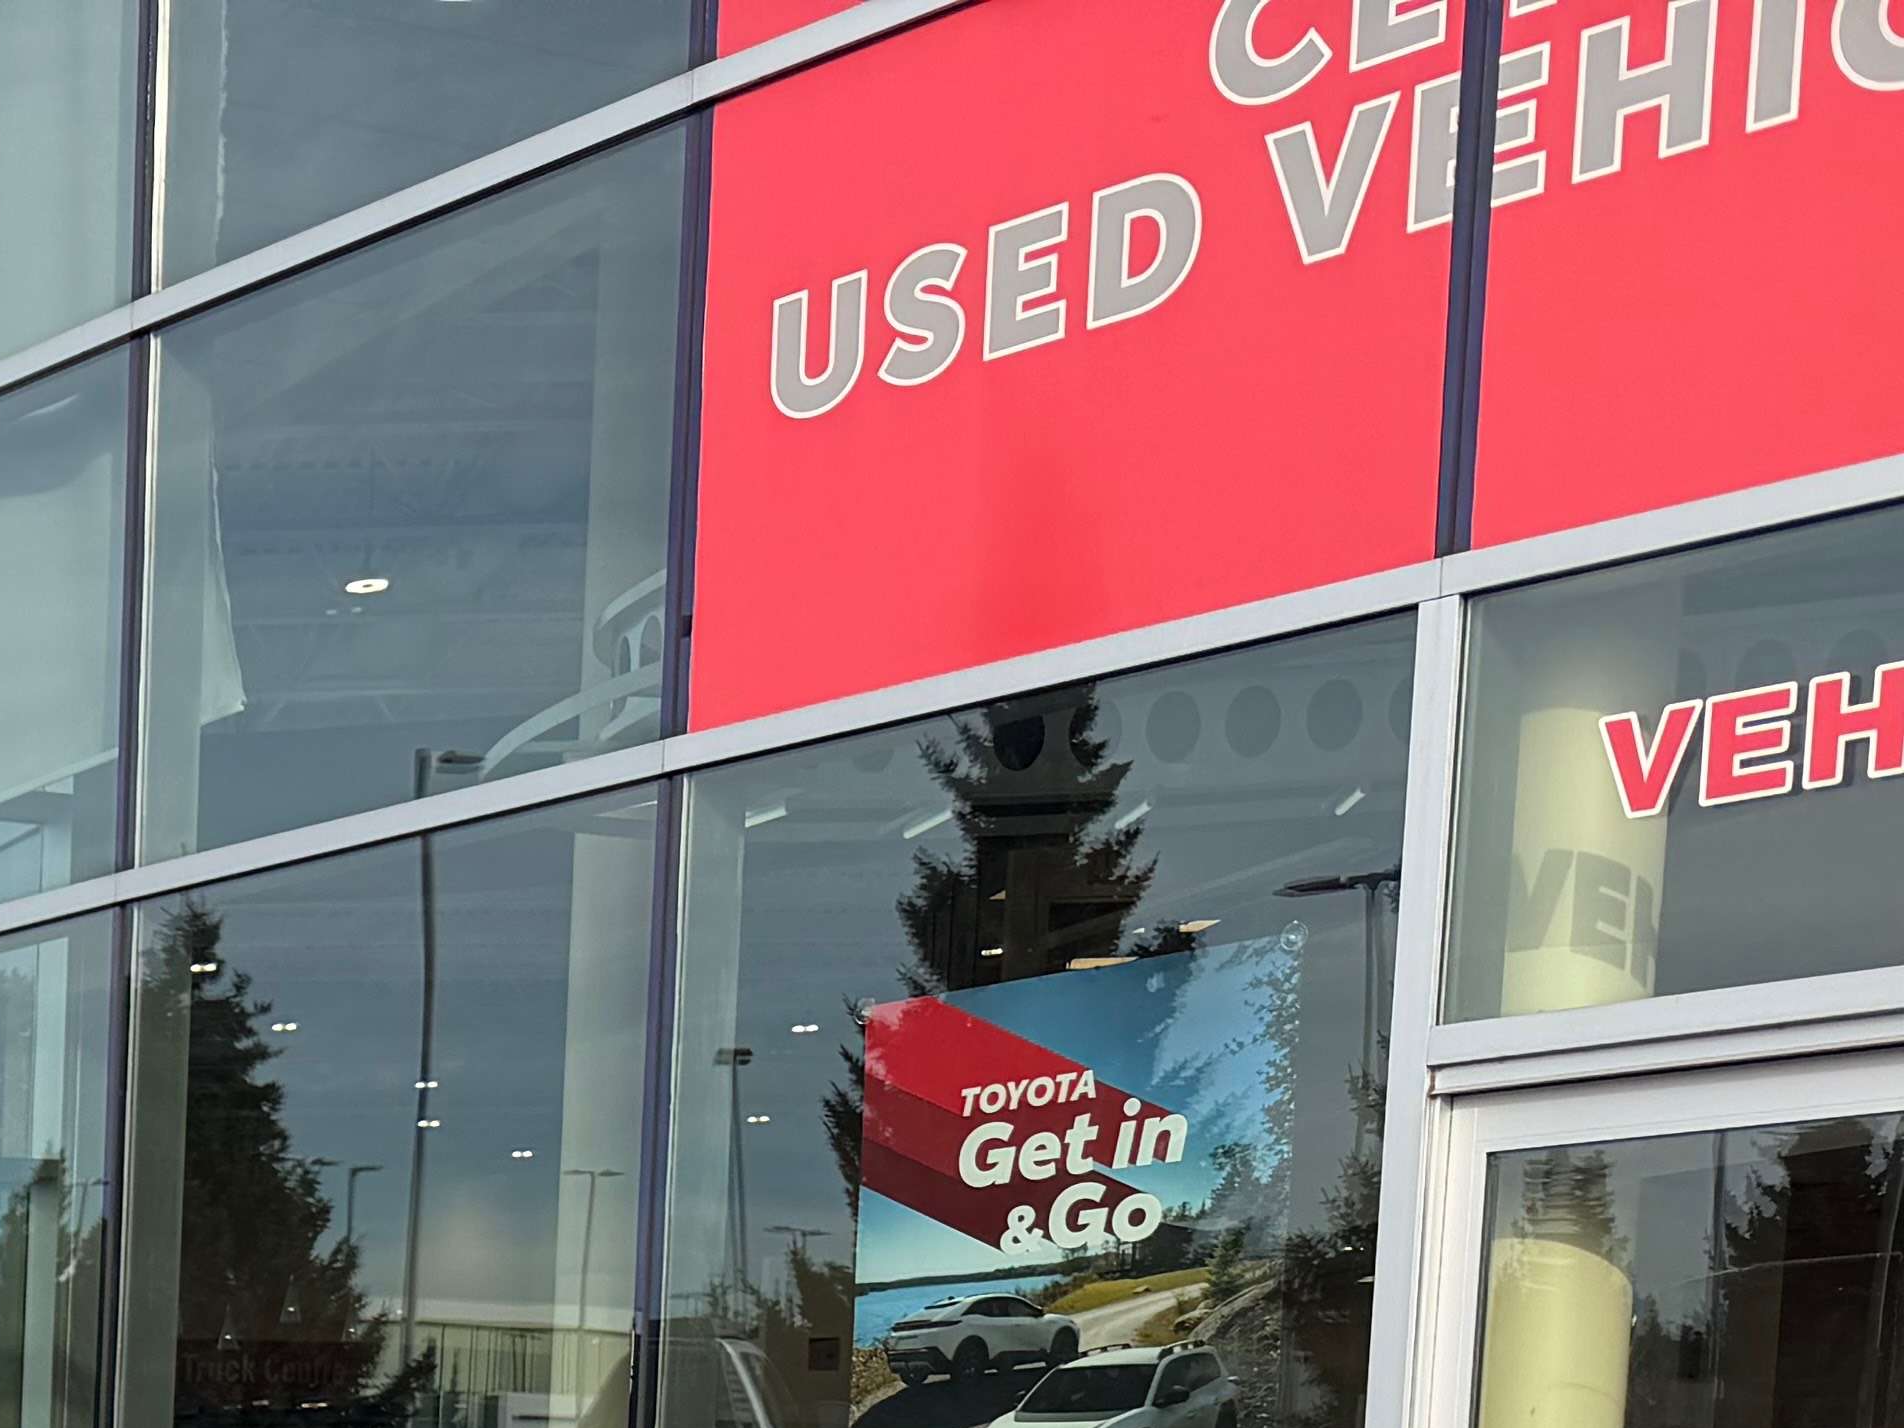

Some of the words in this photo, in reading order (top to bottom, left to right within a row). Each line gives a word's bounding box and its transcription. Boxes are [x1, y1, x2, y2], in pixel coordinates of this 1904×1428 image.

[768, 171, 1202, 421] USED
[961, 1070, 1096, 1117] TOYOTA
[958, 1113, 1099, 1188] Get
[1112, 1098, 1188, 1170] in
